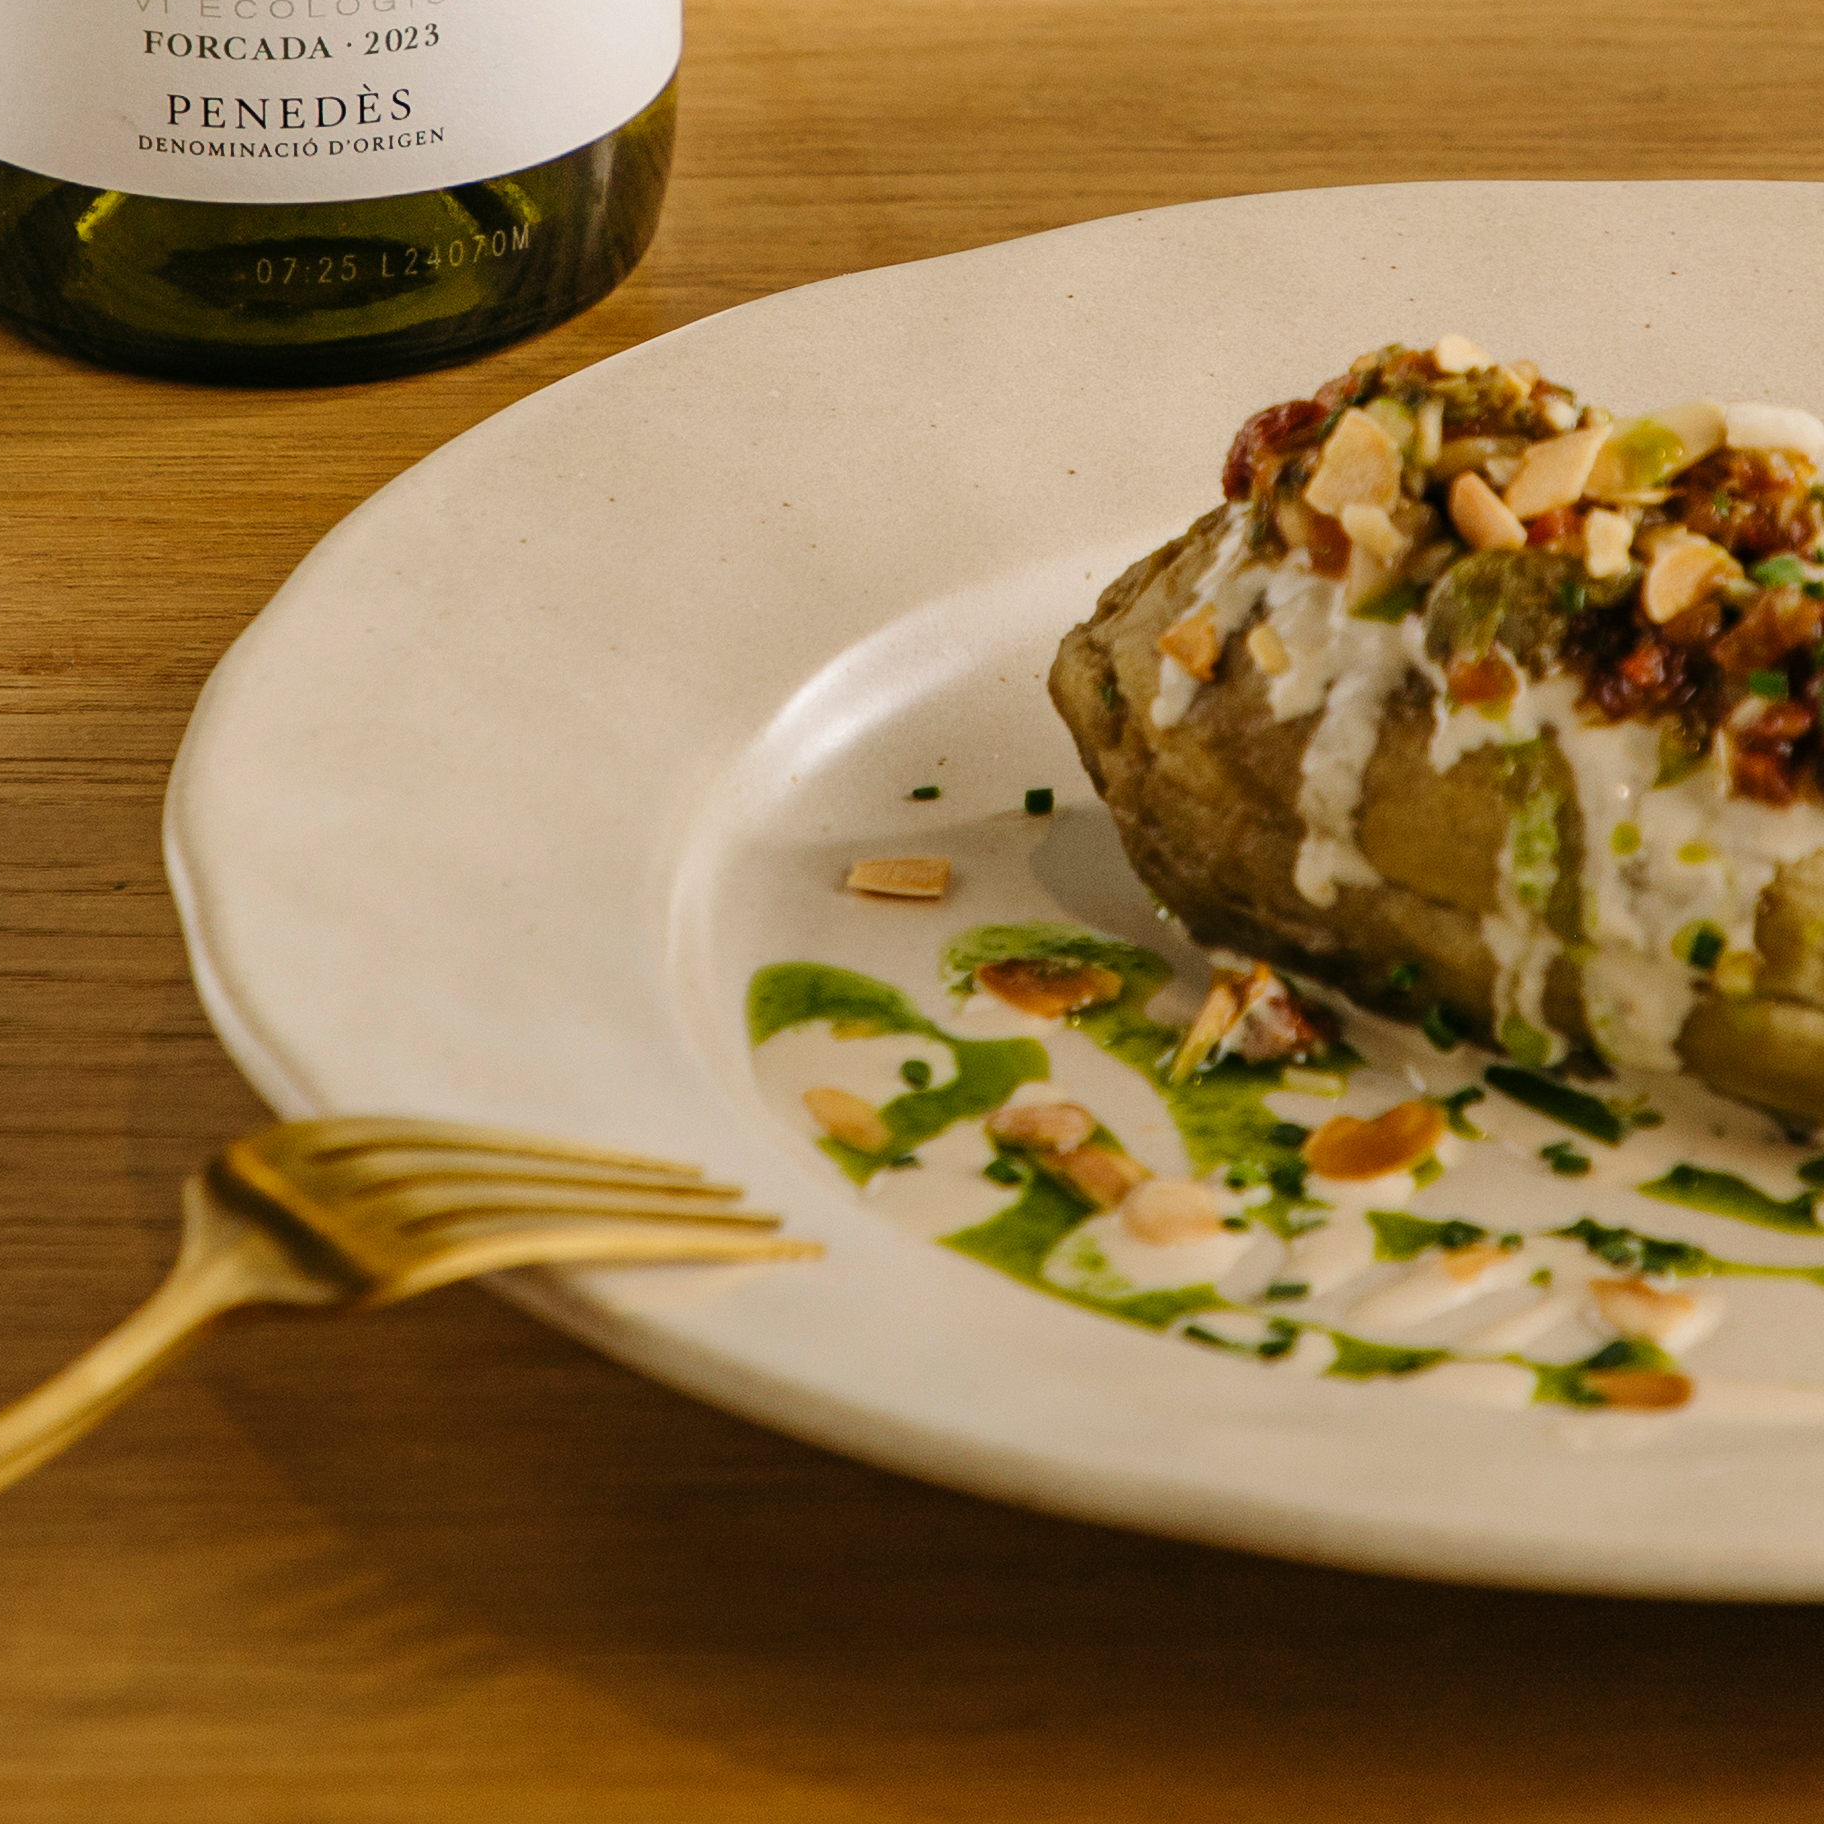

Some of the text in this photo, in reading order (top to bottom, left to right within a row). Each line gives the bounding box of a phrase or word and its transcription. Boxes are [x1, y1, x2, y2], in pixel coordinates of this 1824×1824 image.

[143, 30, 333, 60] FORCADA
[364, 23, 440, 56] 2023
[167, 84, 412, 130] PENEDÈS
[139, 127, 445, 158] DENOMINACIÓ D'ORIGEN
[257, 254, 356, 284] 07:25
